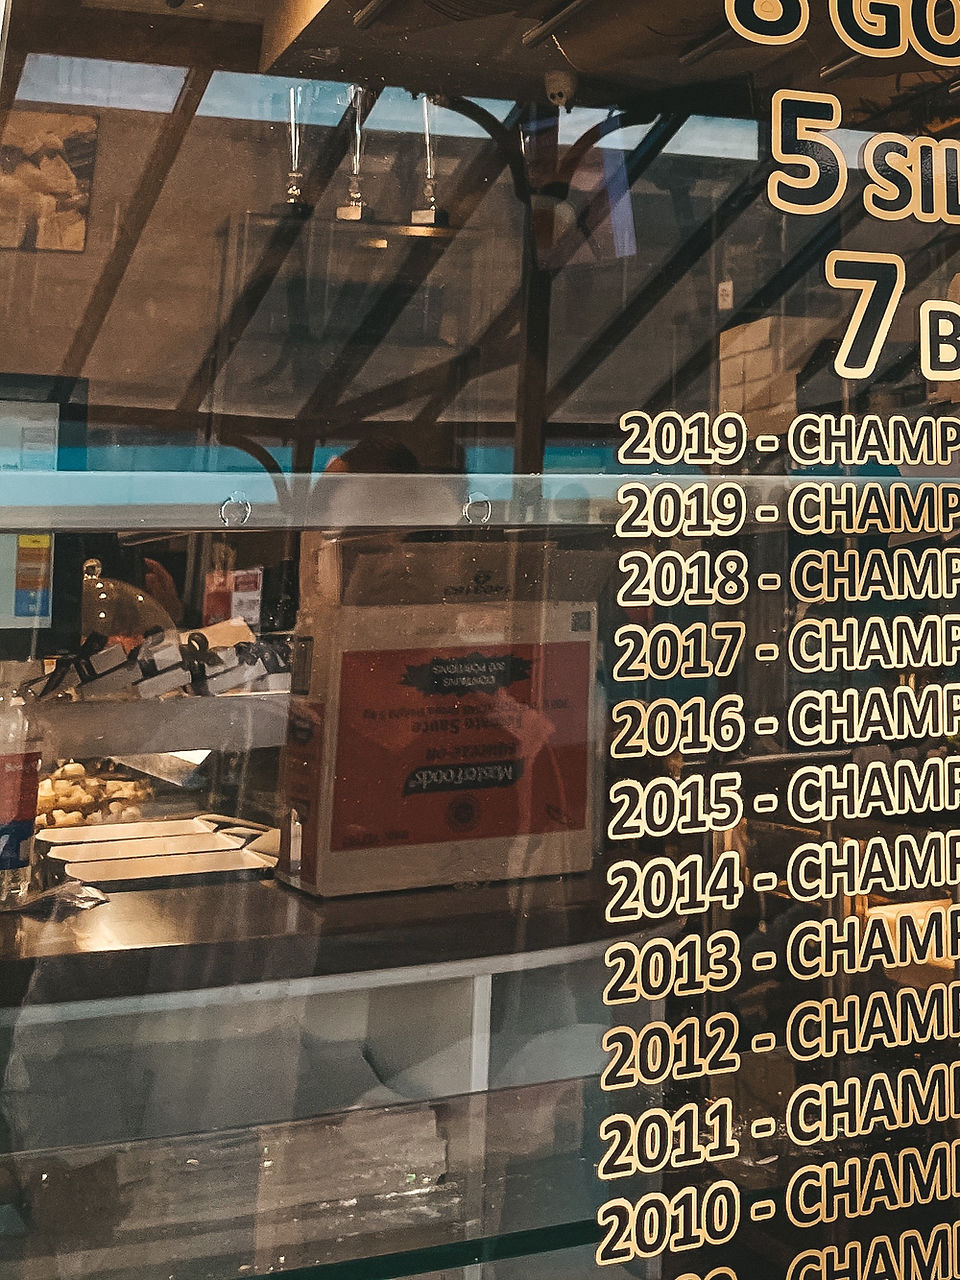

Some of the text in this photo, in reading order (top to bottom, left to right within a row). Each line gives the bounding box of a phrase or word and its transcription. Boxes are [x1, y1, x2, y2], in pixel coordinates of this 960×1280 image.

[768, 89, 848, 215] 5
[825, 250, 906, 379] 7
[616, 411, 747, 466] 2019
[615, 483, 748, 538] 2019
[616, 549, 748, 607] 2018
[612, 620, 746, 682] 2017
[610, 693, 745, 759] 2016
[606, 771, 744, 841] 2015
[605, 851, 743, 923] 2014
[602, 929, 741, 1006] 2013
[600, 1012, 741, 1091] 2012
[597, 1097, 741, 1181] 2011
[595, 1179, 741, 1266] 2010
